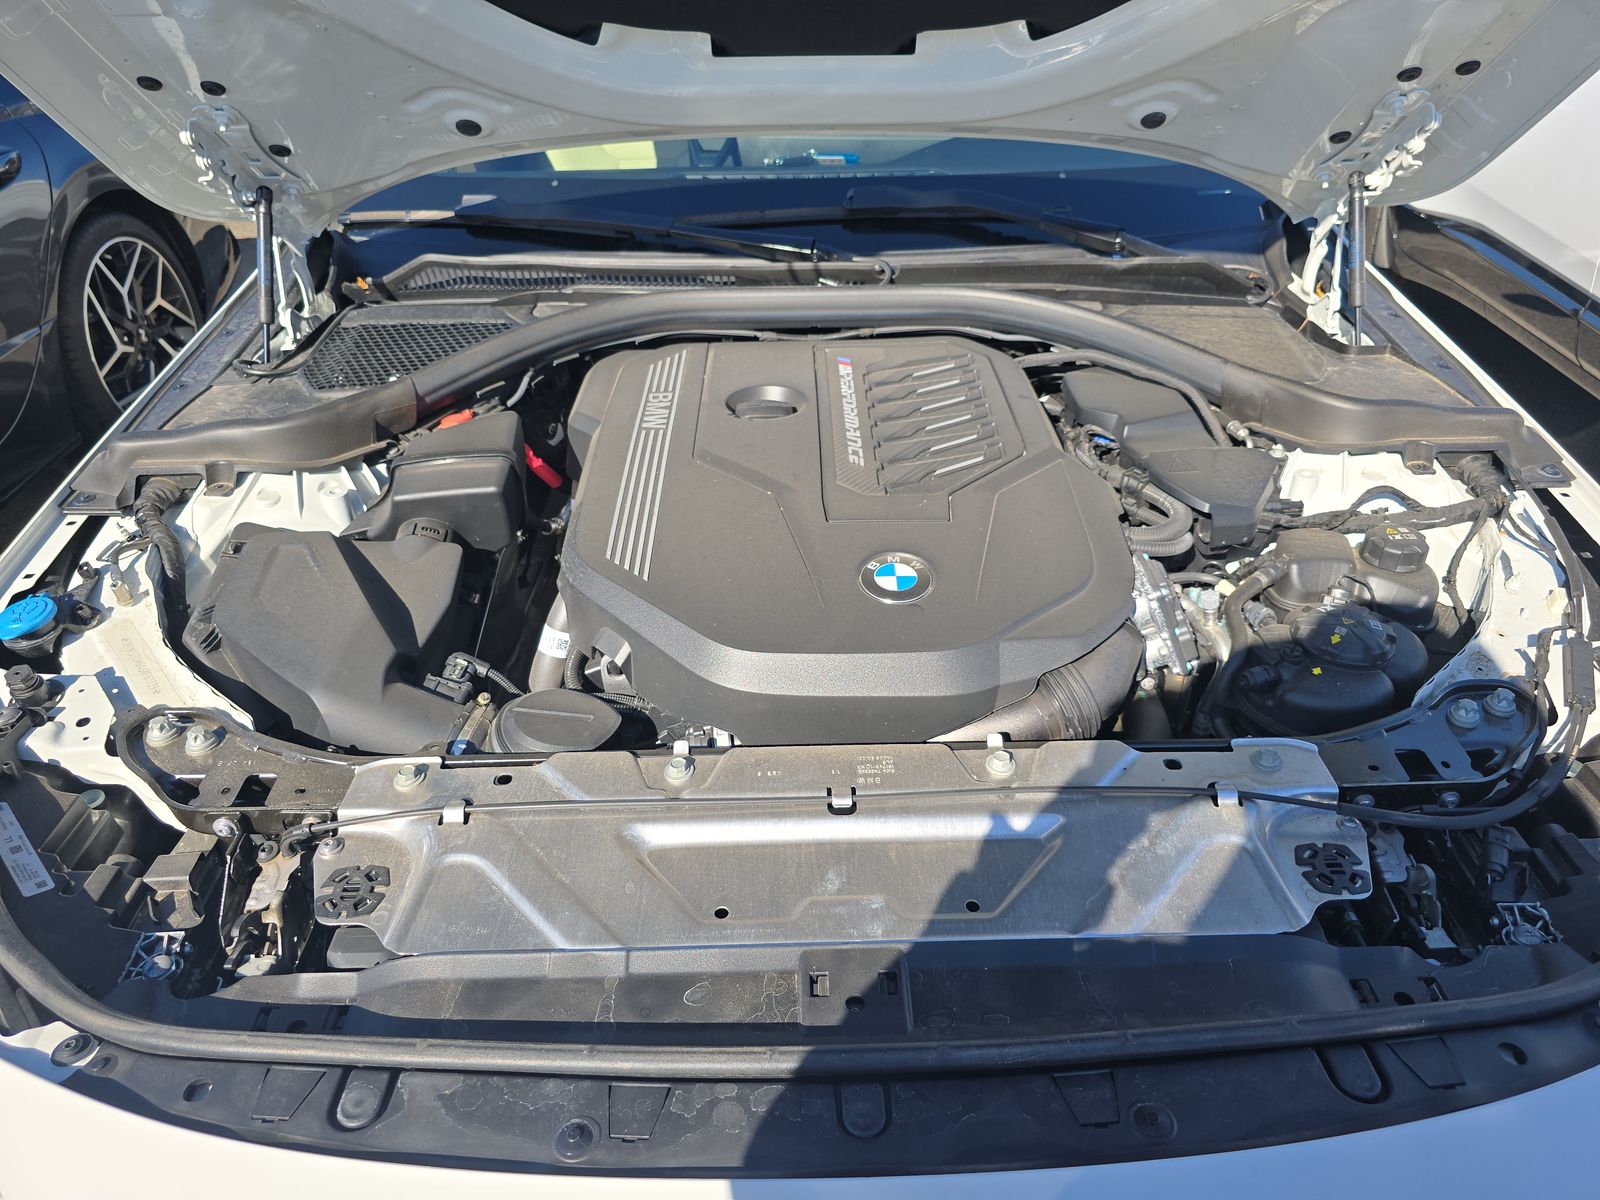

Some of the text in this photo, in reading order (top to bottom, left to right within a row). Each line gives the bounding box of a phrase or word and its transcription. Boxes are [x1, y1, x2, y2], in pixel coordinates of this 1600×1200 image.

[642, 392, 673, 429] BMW
[840, 372, 865, 467] PERFORMANCE
[866, 556, 924, 571] BMW
[858, 776, 881, 784] BMW
